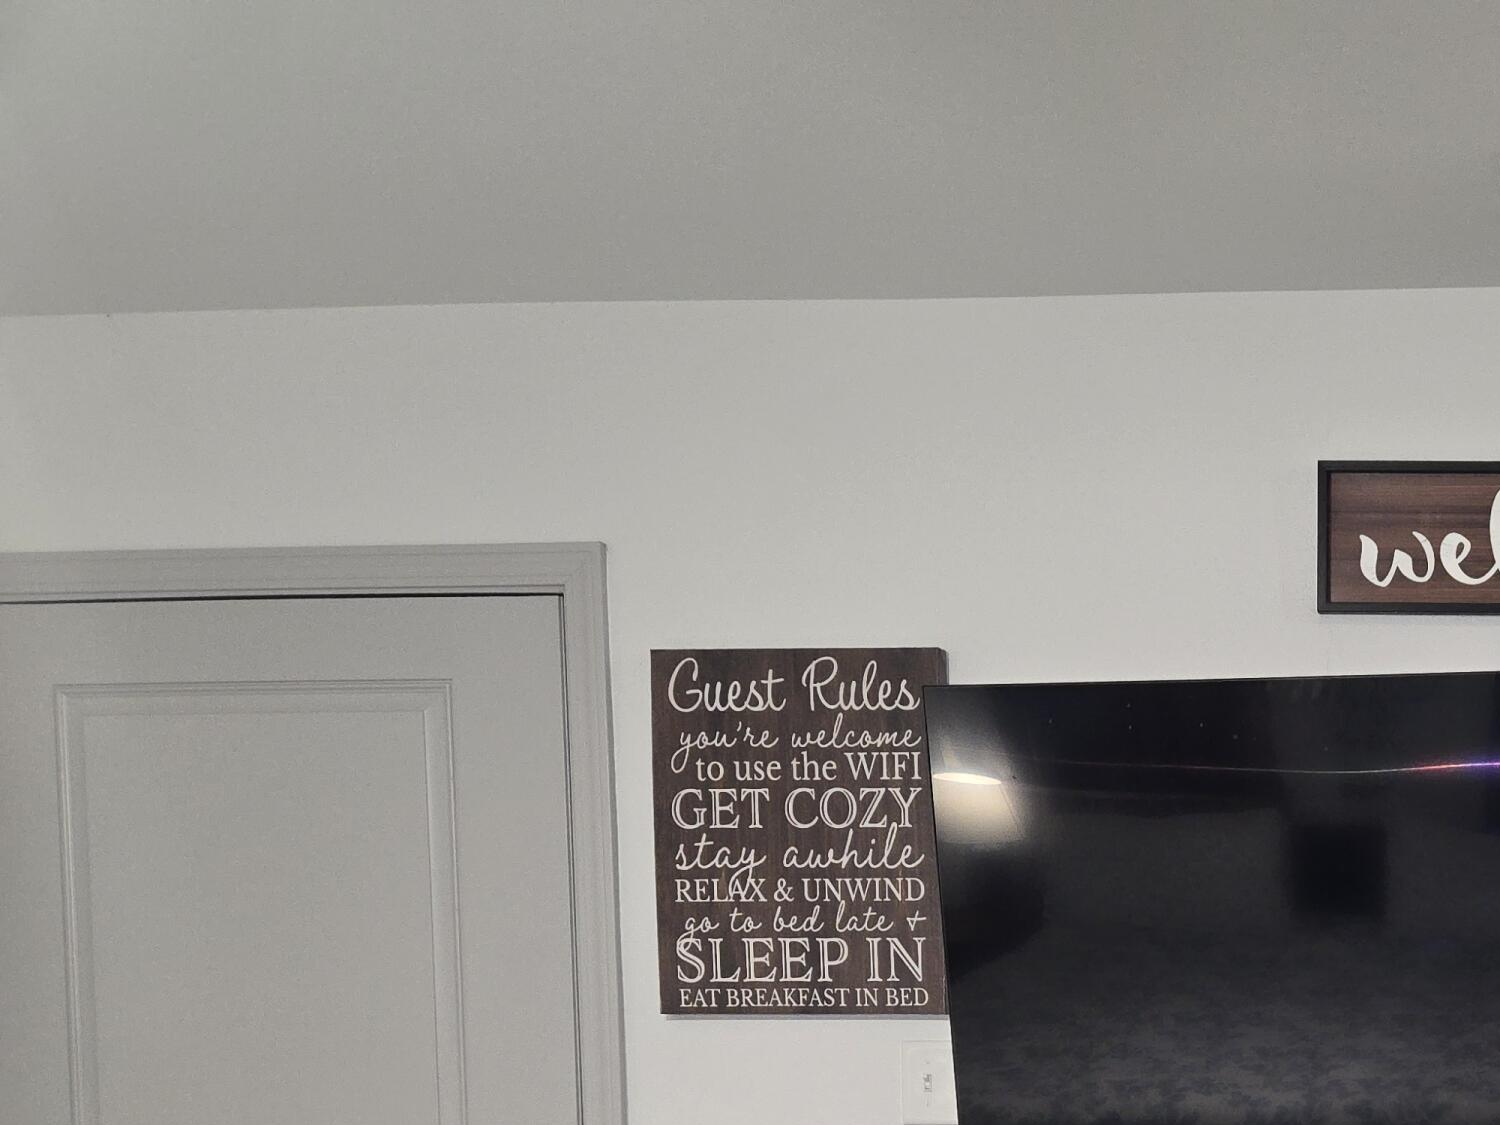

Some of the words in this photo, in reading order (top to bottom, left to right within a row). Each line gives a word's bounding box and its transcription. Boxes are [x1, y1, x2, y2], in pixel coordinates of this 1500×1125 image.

[667, 657, 786, 713] Guest
[801, 656, 920, 712] Rules
[670, 721, 778, 773] you're
[791, 712, 922, 749] welcome
[696, 758, 724, 781] to
[733, 760, 782, 781] use
[790, 751, 837, 780] the
[844, 752, 922, 780] WIFI
[671, 788, 770, 829] GET
[784, 787, 922, 829] COZY
[674, 833, 767, 901] stay
[783, 822, 925, 869] awhile
[674, 878, 768, 902] RELAX
[773, 878, 794, 902] &
[801, 877, 925, 902] UNWIND
[676, 916, 720, 953] go
[729, 906, 763, 932] to
[773, 905, 825, 932] bed
[835, 900, 894, 932] late
[676, 937, 849, 983] SLEEP
[866, 937, 926, 982] IN
[679, 988, 721, 1007] EAT
[726, 988, 849, 1007] BREAKFAST
[855, 988, 878, 1007] IN
[885, 987, 929, 1007] BED
